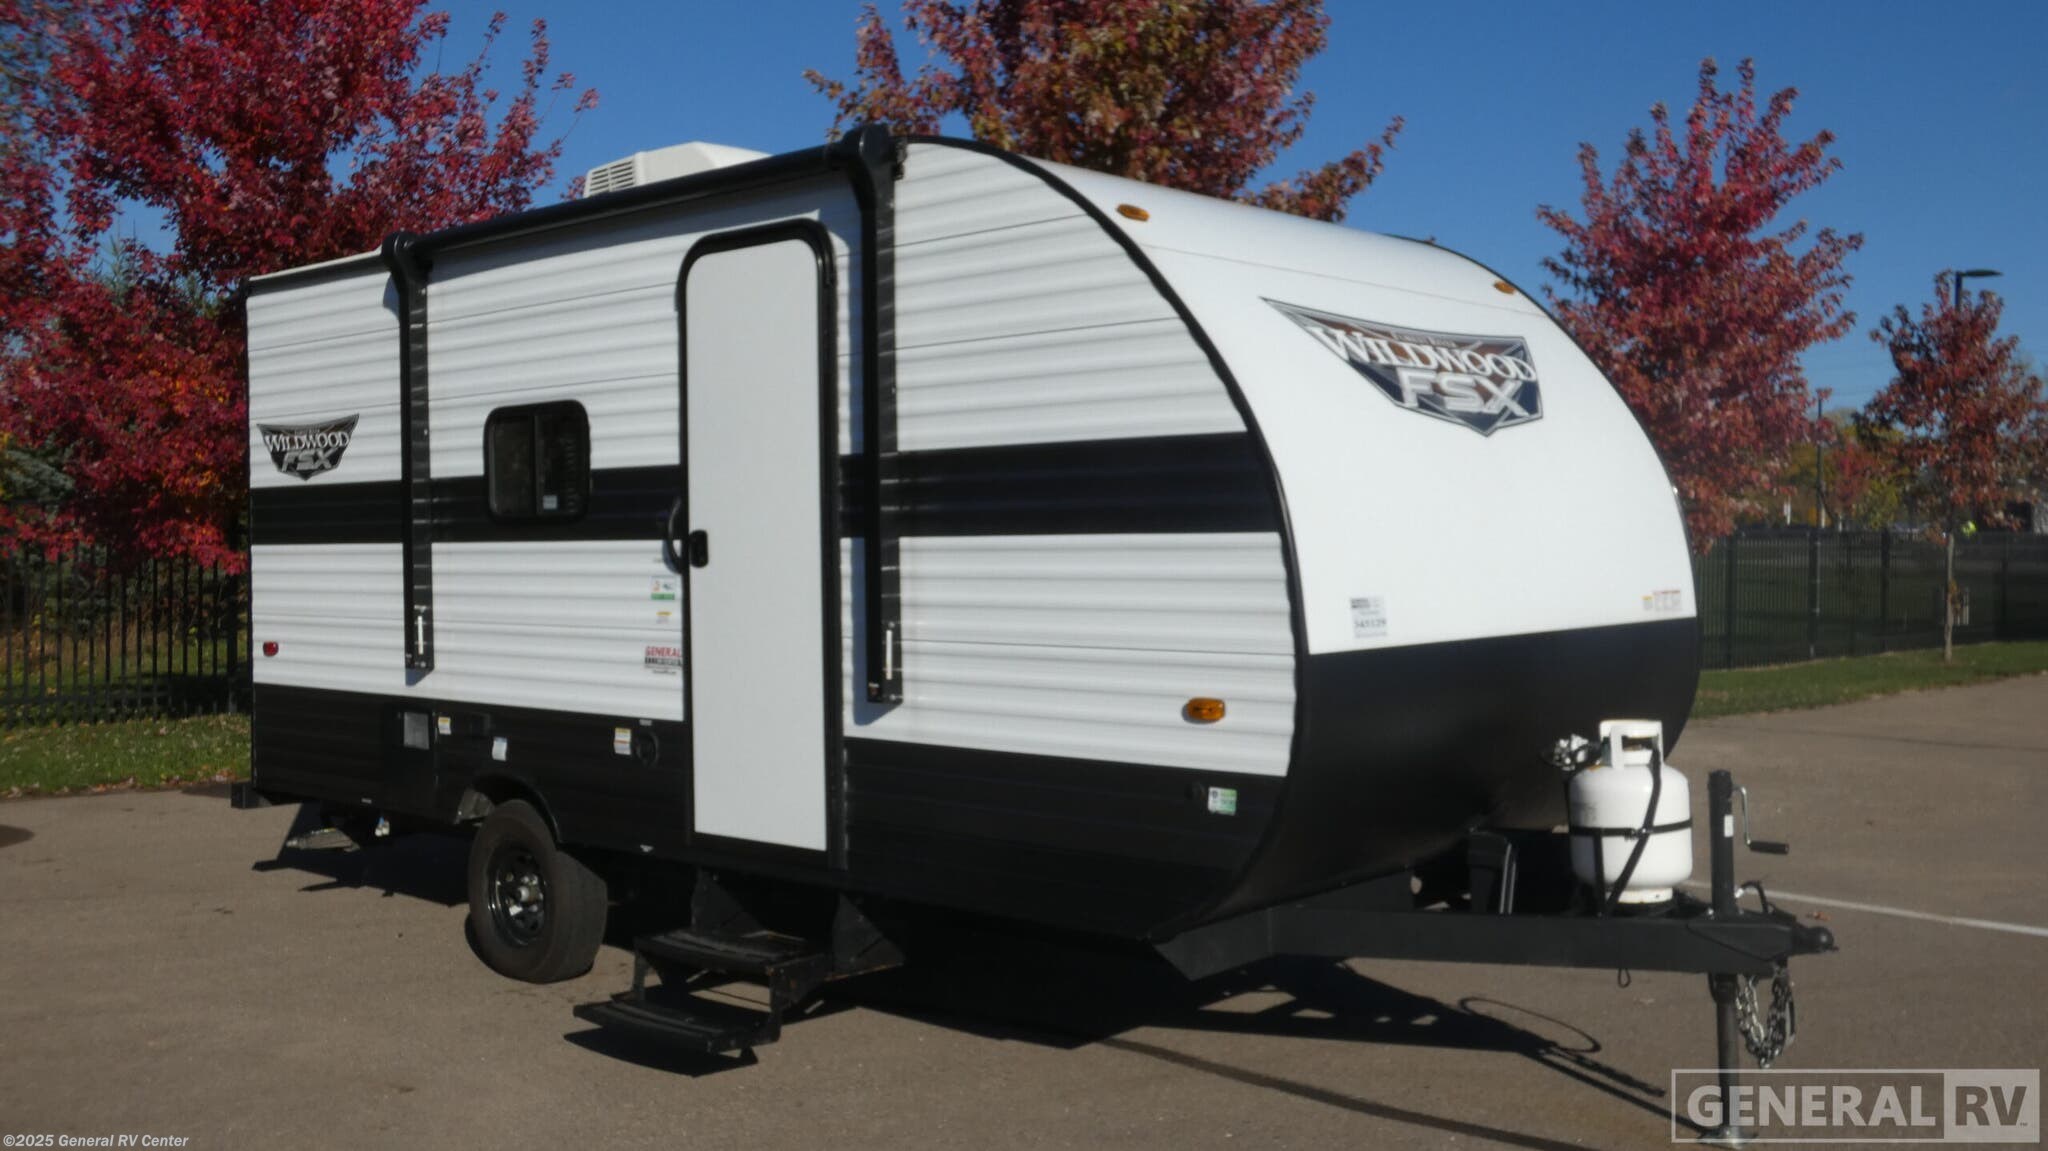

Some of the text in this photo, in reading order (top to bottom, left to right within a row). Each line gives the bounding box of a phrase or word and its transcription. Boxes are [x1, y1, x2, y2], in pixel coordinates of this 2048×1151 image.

[1305, 325, 1536, 382] WILDWOOD
[1396, 366, 1530, 417] FSX
[265, 431, 349, 452] WILDWOOD
[282, 447, 338, 472] FSX
